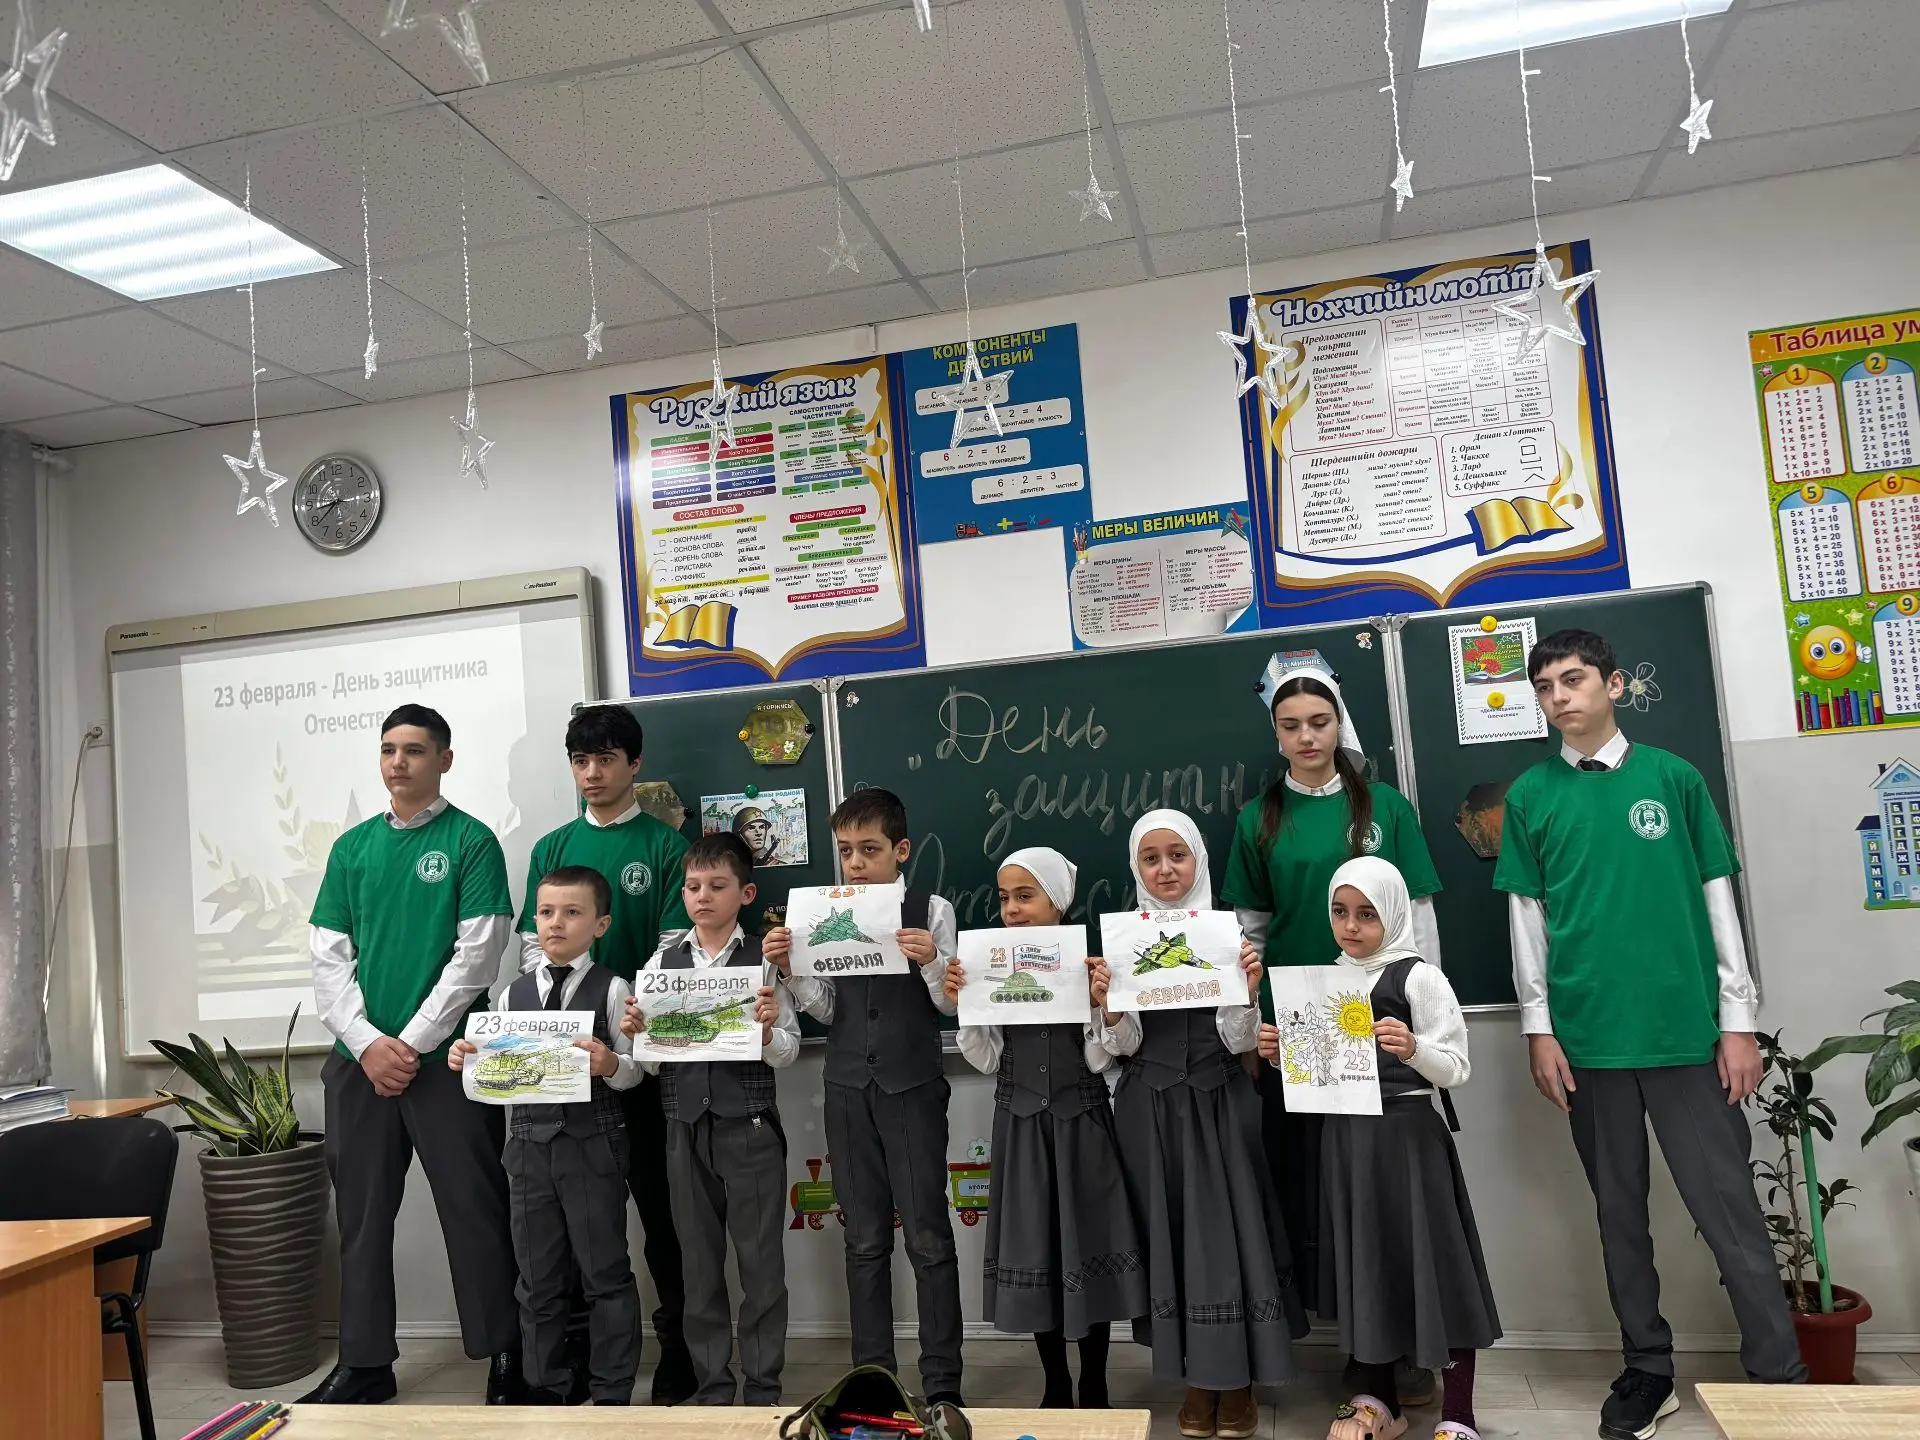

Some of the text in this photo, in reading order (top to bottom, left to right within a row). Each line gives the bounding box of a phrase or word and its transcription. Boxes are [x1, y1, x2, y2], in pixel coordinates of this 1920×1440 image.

[1270, 282, 1427, 327] Нохчийн
[1770, 323, 1885, 353] Таблица
[932, 329, 1046, 360] КОМОНЕНТЫ
[948, 347, 1034, 376] ДЕСТВИЙ
[1870, 357, 1881, 369] 2
[1793, 368, 1802, 381] 1
[780, 377, 856, 406] язык
[985, 383, 992, 391] 8
[789, 402, 854, 415] САМОСТОЯТЕЛЬНЫЕ
[1009, 409, 1015, 418] 2
[1037, 405, 1043, 413] 4
[944, 445, 1007, 461] 6 2 12
[1460, 445, 1481, 453] Орам
[331, 465, 342, 475] 12
[349, 467, 353, 477] 1
[1461, 462, 1481, 471] Лард
[357, 477, 365, 488] 2
[998, 472, 1056, 487] 6 2 3
[1463, 480, 1500, 491] Суффикс
[1886, 476, 1897, 490] 6
[309, 484, 318, 494] 10
[1807, 486, 1817, 499] 5
[306, 501, 313, 511] 9
[360, 509, 367, 518] 4
[679, 507, 737, 519] СОСТАВ СЛОВА
[312, 516, 319, 526] 8
[1092, 510, 1220, 539] МЕРЫ ВЕЛИЧИН
[322, 526, 329, 536] 7
[336, 528, 343, 539] 6
[350, 522, 358, 533] 5
[673, 533, 712, 544] ОКОНЧАНИЕ
[673, 542, 724, 553] ОСНОВА СЛОВА
[674, 554, 700, 562] КОРЕНЬ
[675, 562, 712, 572] ПРИСТАВКА
[675, 573, 706, 582] СУФФИКС
[1837, 587, 1848, 595] 50
[1903, 597, 1913, 611] 9
[214, 659, 488, 709] 23 февраля День защитника
[304, 709, 393, 736] Отечеств
[1893, 804, 1900, 812] Б
[1898, 854, 1907, 862] Ж
[990, 948, 1006, 962] 23
[813, 952, 884, 972] ФЕВРАЛЯ
[642, 973, 749, 996] 23 февраля
[1136, 979, 1221, 1007] ФЕВРАЛЯ
[474, 1015, 580, 1036] 23 февраля
[1344, 1050, 1370, 1071] 23
[975, 1146, 984, 1155] 2
